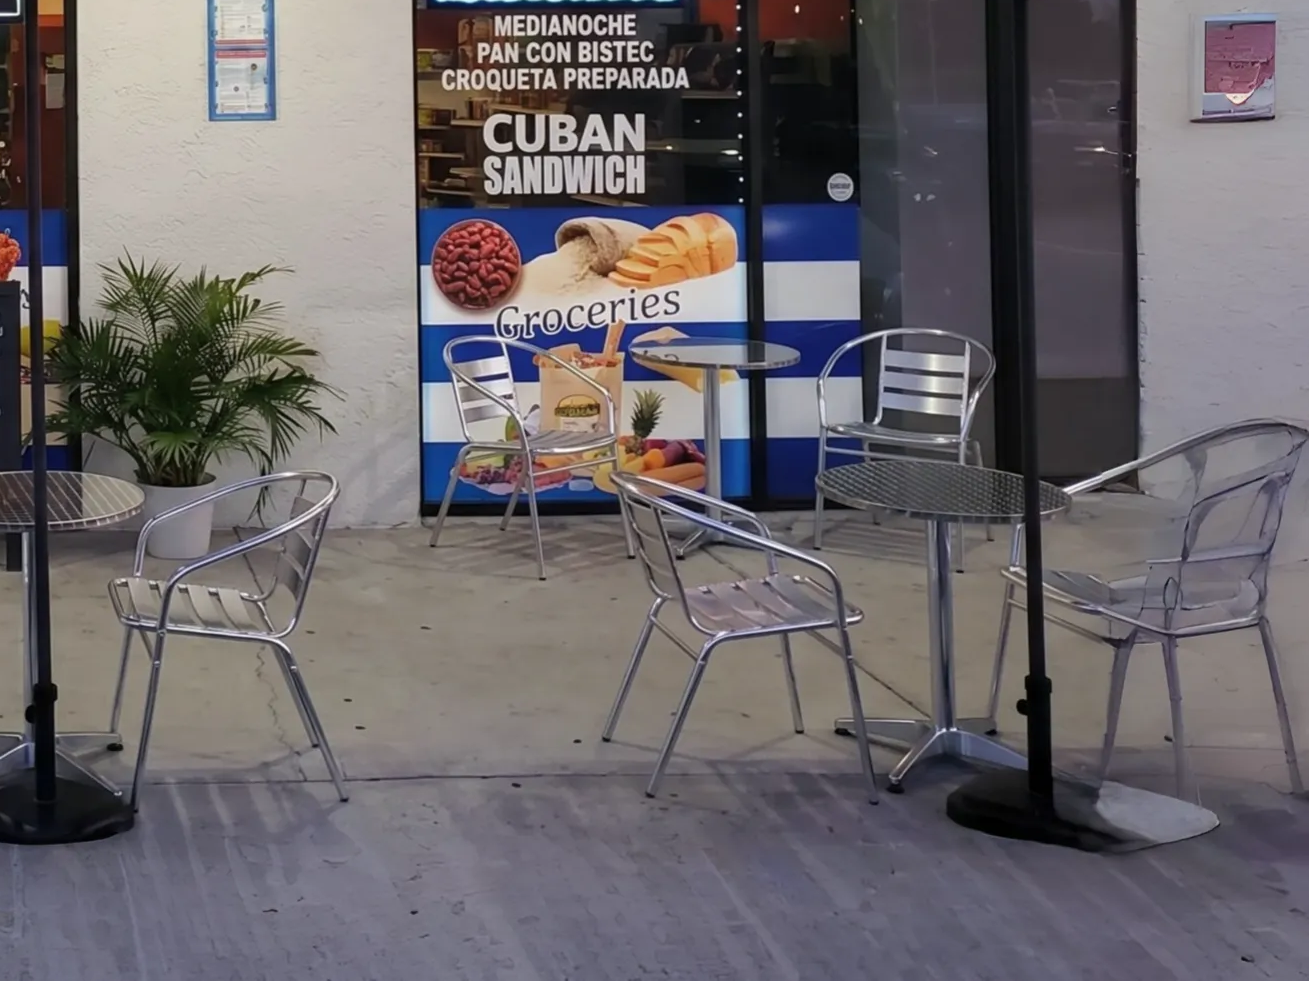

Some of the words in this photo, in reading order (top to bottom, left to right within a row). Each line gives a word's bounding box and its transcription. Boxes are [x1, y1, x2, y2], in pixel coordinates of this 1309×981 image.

[494, 14, 637, 37] MEDIANOCHE
[477, 42, 519, 64] PAN
[525, 42, 572, 63] CON
[577, 40, 655, 63] BISTEC
[441, 68, 558, 92] CROQUETA
[563, 66, 691, 90] PREPARADA
[482, 113, 646, 153] CUBAN
[483, 154, 646, 195] SANDWICH
[493, 287, 682, 340] Groceries
